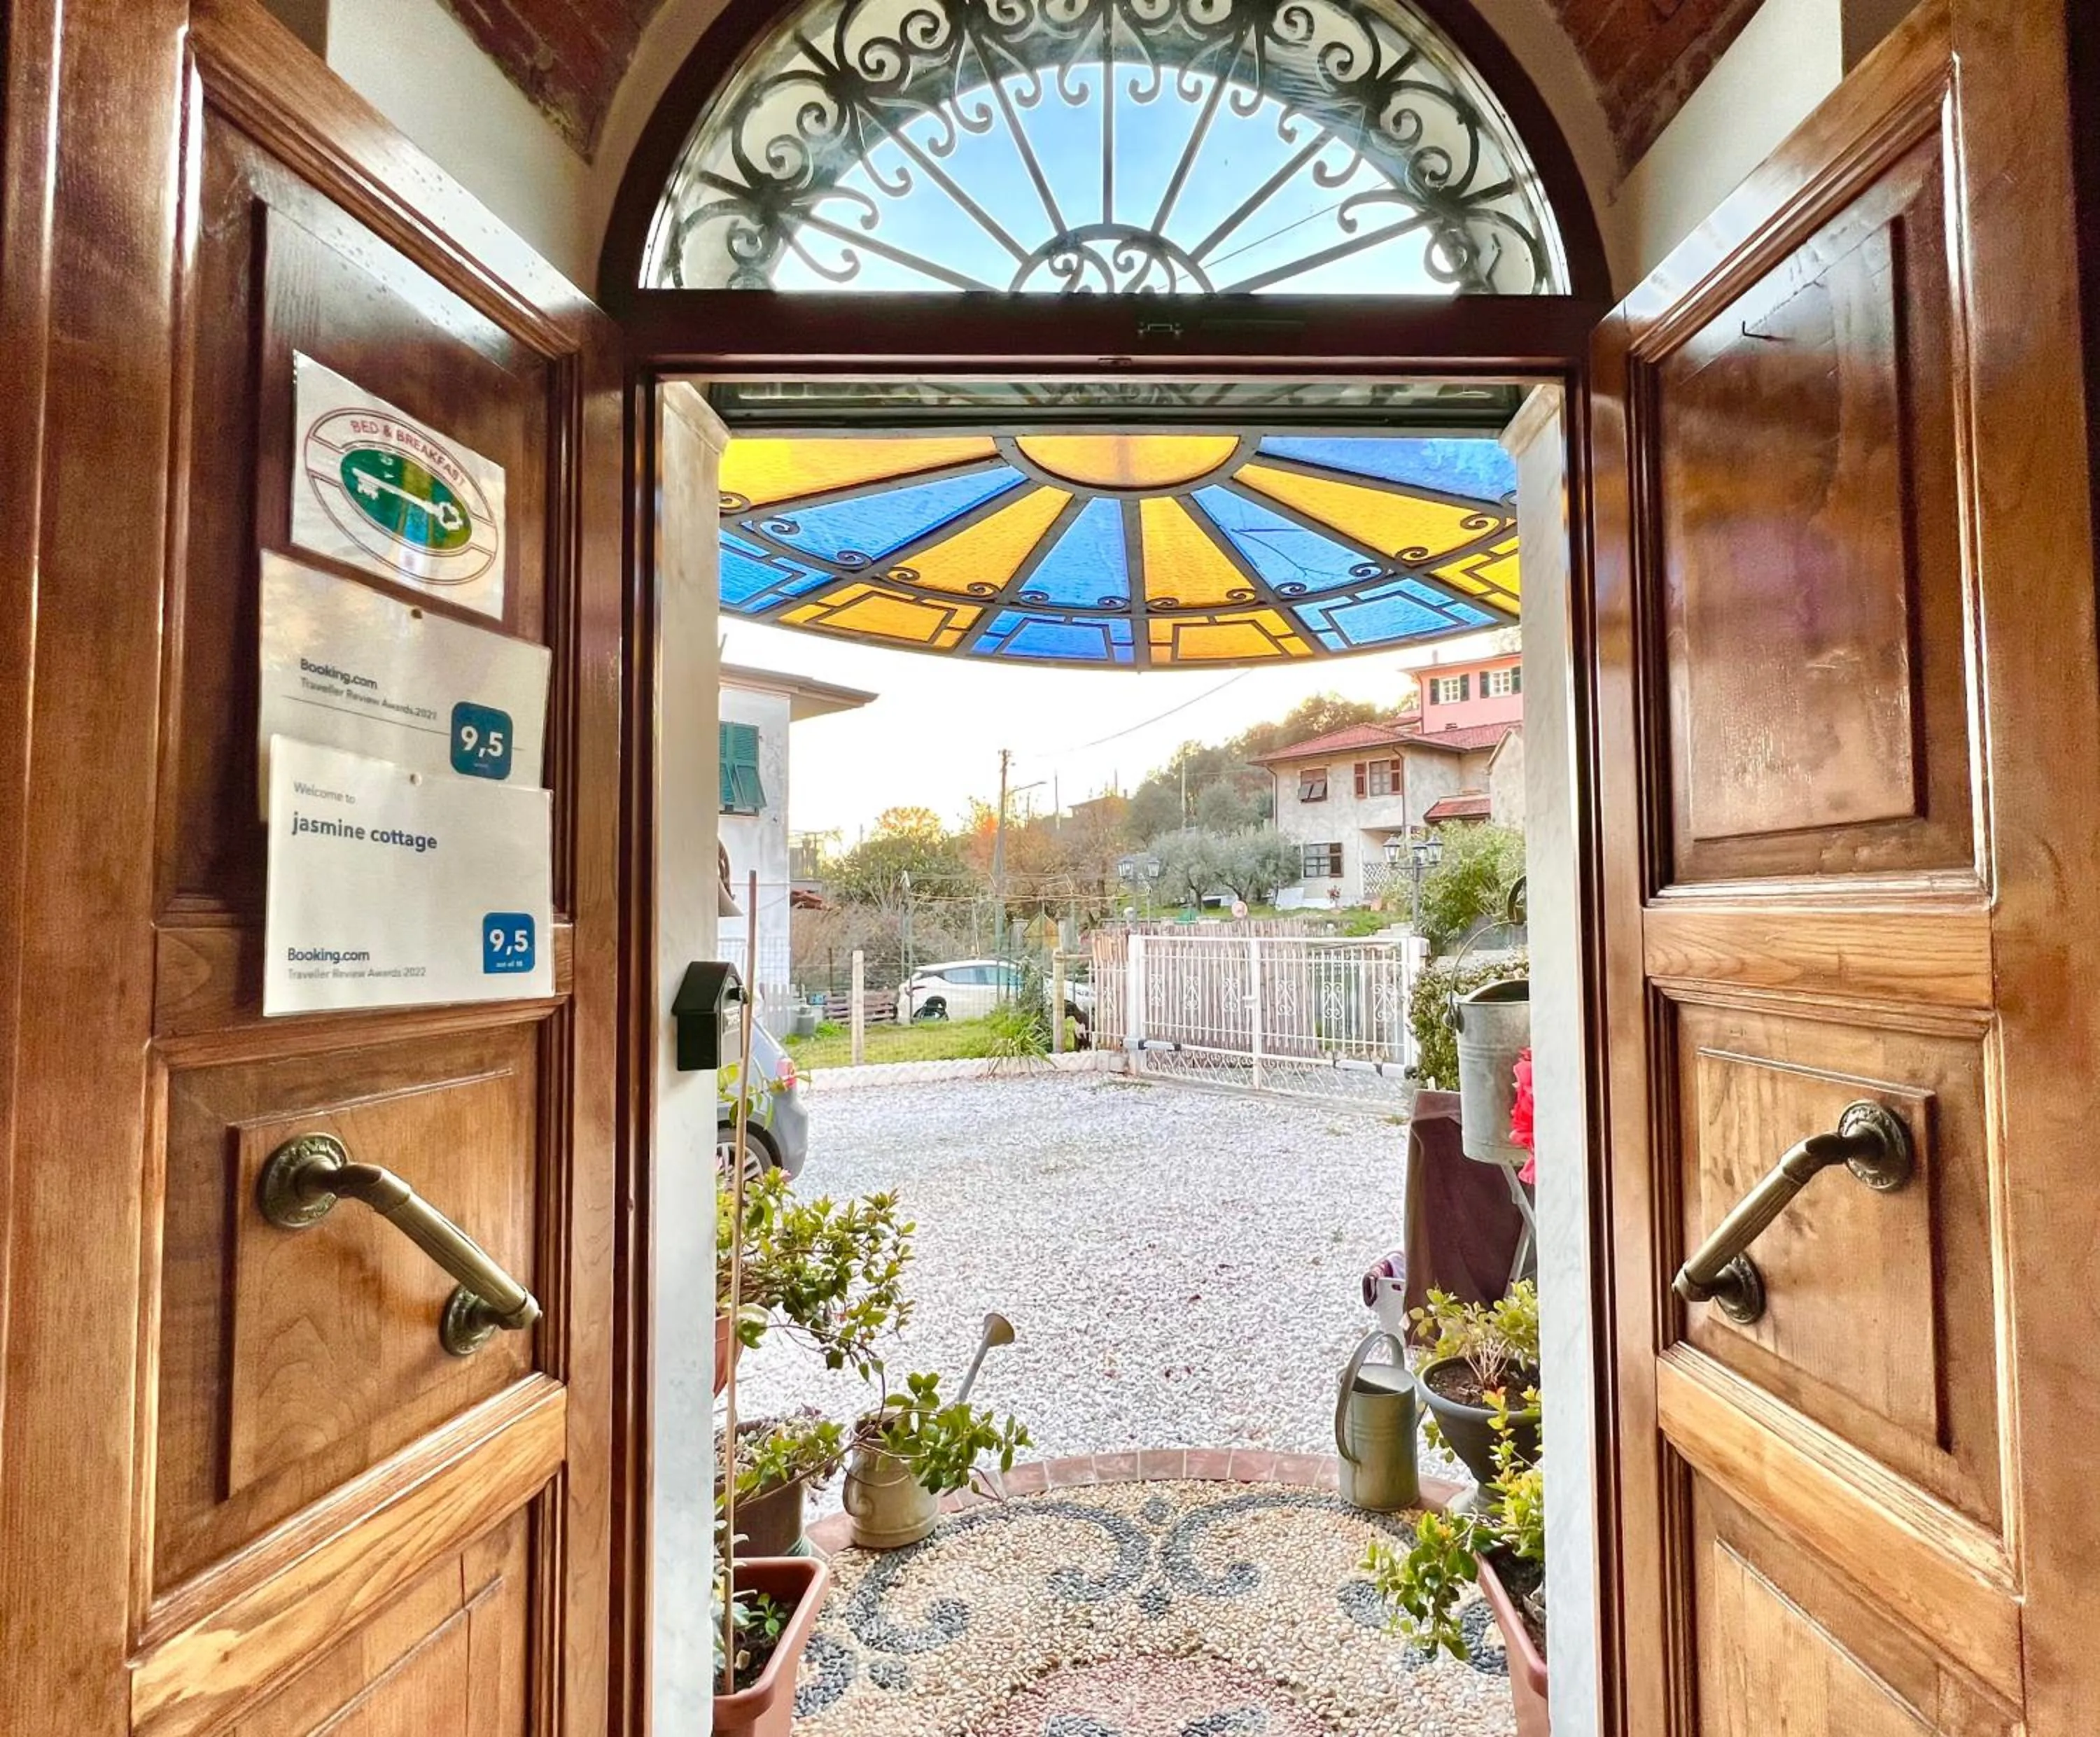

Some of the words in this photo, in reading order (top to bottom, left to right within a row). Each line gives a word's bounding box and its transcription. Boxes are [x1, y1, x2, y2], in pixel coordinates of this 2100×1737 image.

[351, 421, 379, 435] BED
[383, 426, 393, 437] &
[396, 430, 465, 486] BREAKFAST
[300, 658, 378, 689] Booking.com
[461, 726, 503, 758] 9,5
[293, 781, 344, 801] Welcome
[346, 794, 356, 804] to
[292, 810, 365, 840] jasmine
[370, 829, 438, 852] cottage
[288, 947, 370, 964] Booking.com
[489, 929, 528, 955] 9,5
